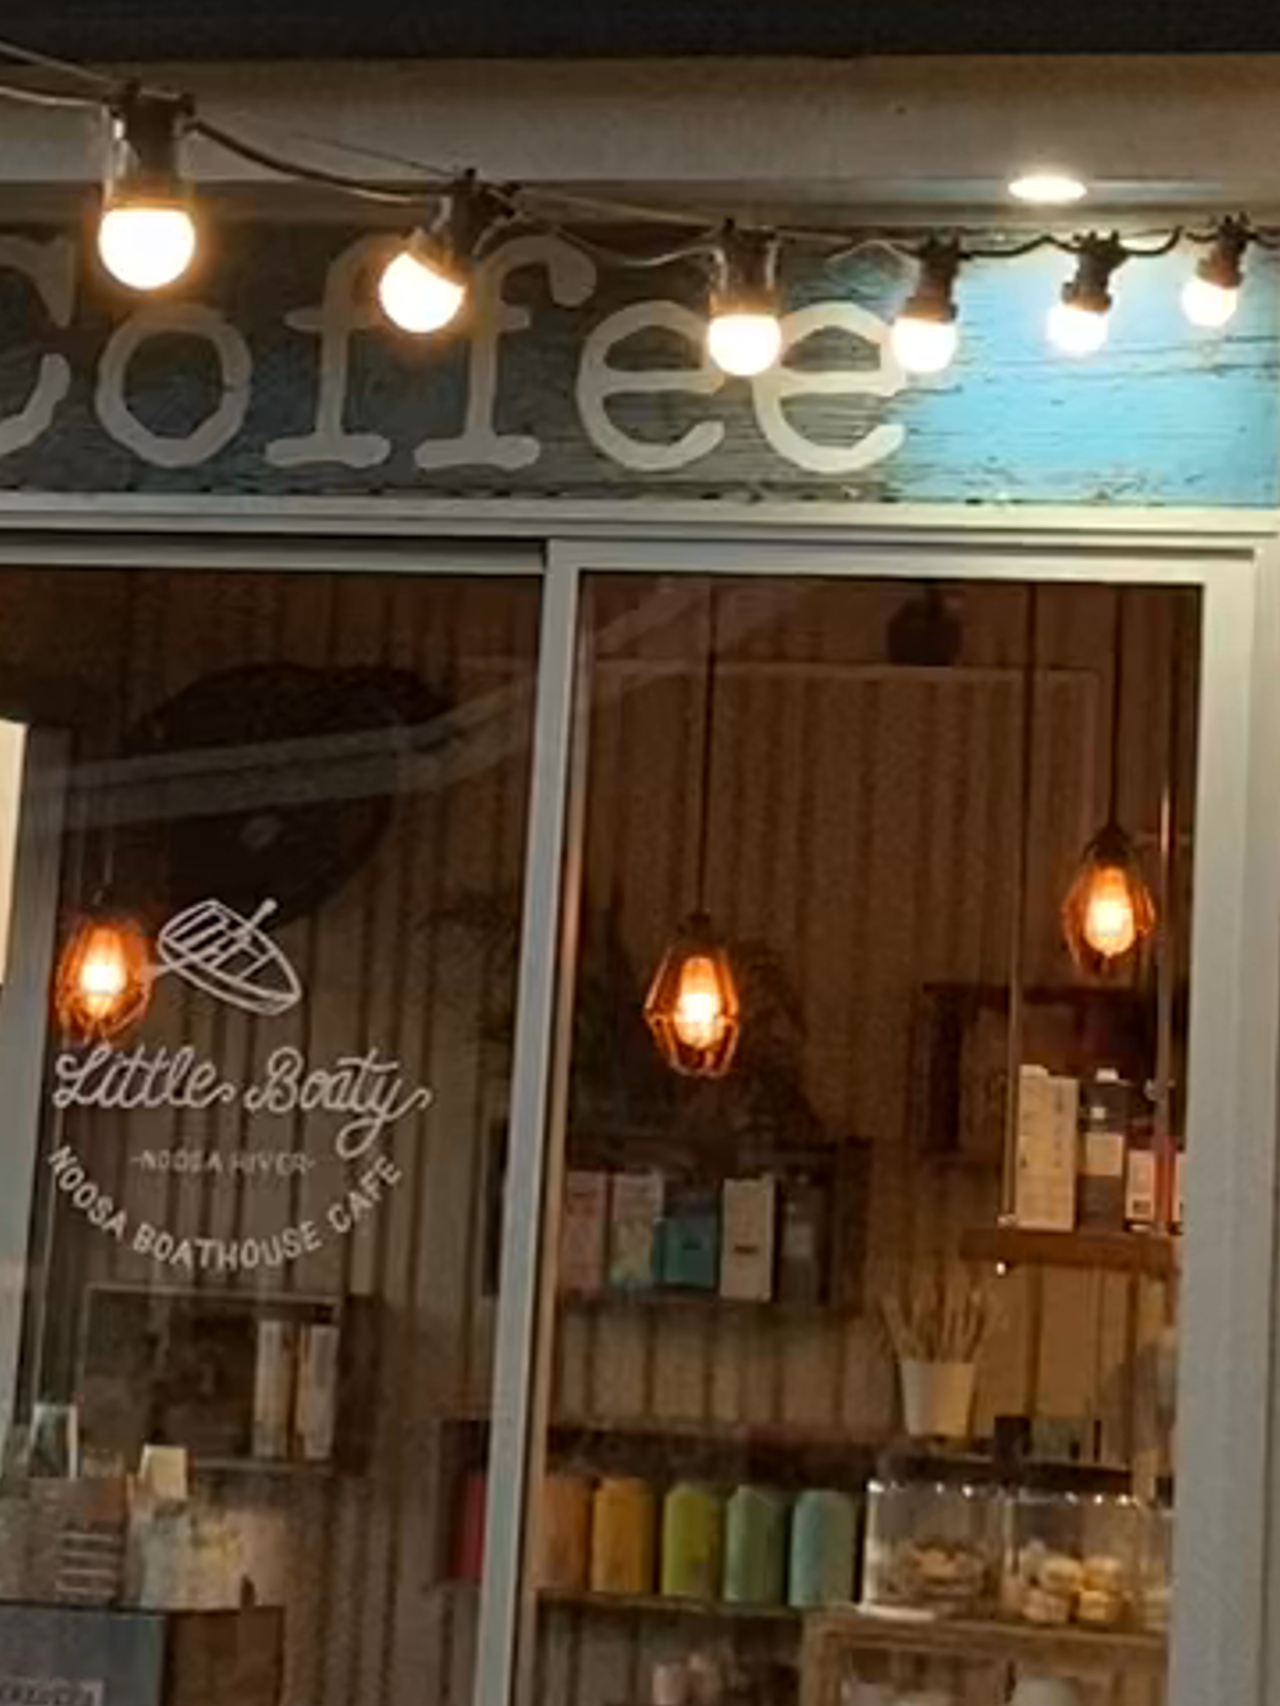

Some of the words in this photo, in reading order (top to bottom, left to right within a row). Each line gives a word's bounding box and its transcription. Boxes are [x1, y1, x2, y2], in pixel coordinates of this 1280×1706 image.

[52, 1044, 236, 1110] Little
[244, 1046, 432, 1160] Boaty
[47, 1146, 128, 1242] NOOSA
[132, 1220, 323, 1271] BOATHOUSE
[326, 1156, 403, 1234] CAFE
